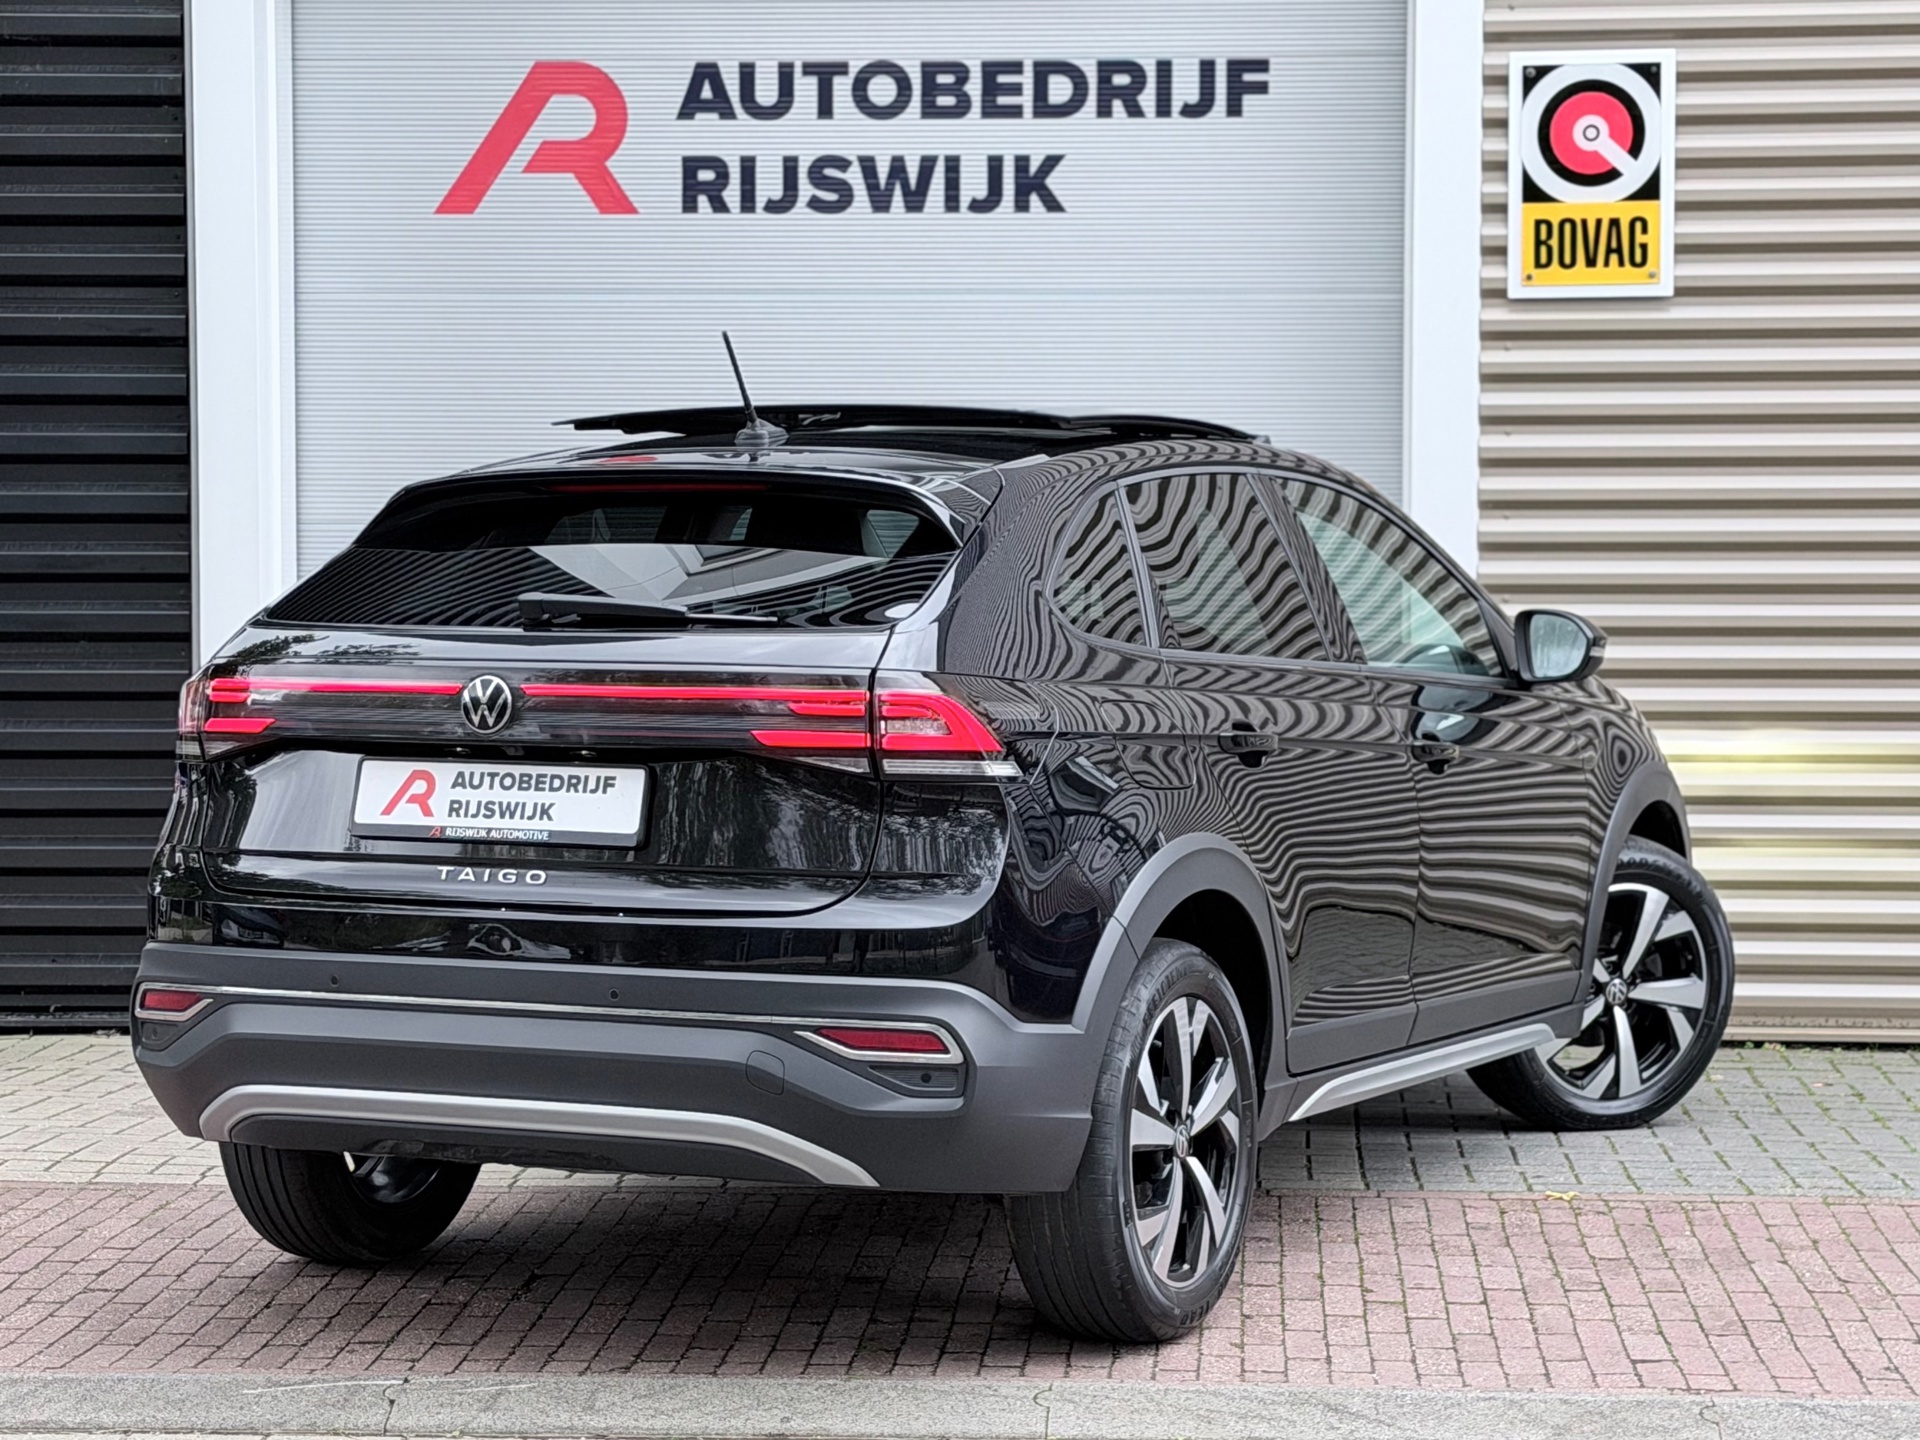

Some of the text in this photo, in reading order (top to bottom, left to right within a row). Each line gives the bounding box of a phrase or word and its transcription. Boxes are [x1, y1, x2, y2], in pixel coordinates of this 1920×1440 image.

[676, 58, 1270, 121] AUTOBEDRIJF
[681, 153, 1068, 214] RIJSWIJK
[1533, 216, 1649, 269] BOVAG
[450, 770, 617, 795] AUTOBEDRIJF
[447, 799, 556, 822] RIJSWIJK
[445, 827, 488, 839] RIJSWIJK
[489, 829, 549, 841] AUTOMOTIVE
[437, 866, 547, 885] TAIGO
